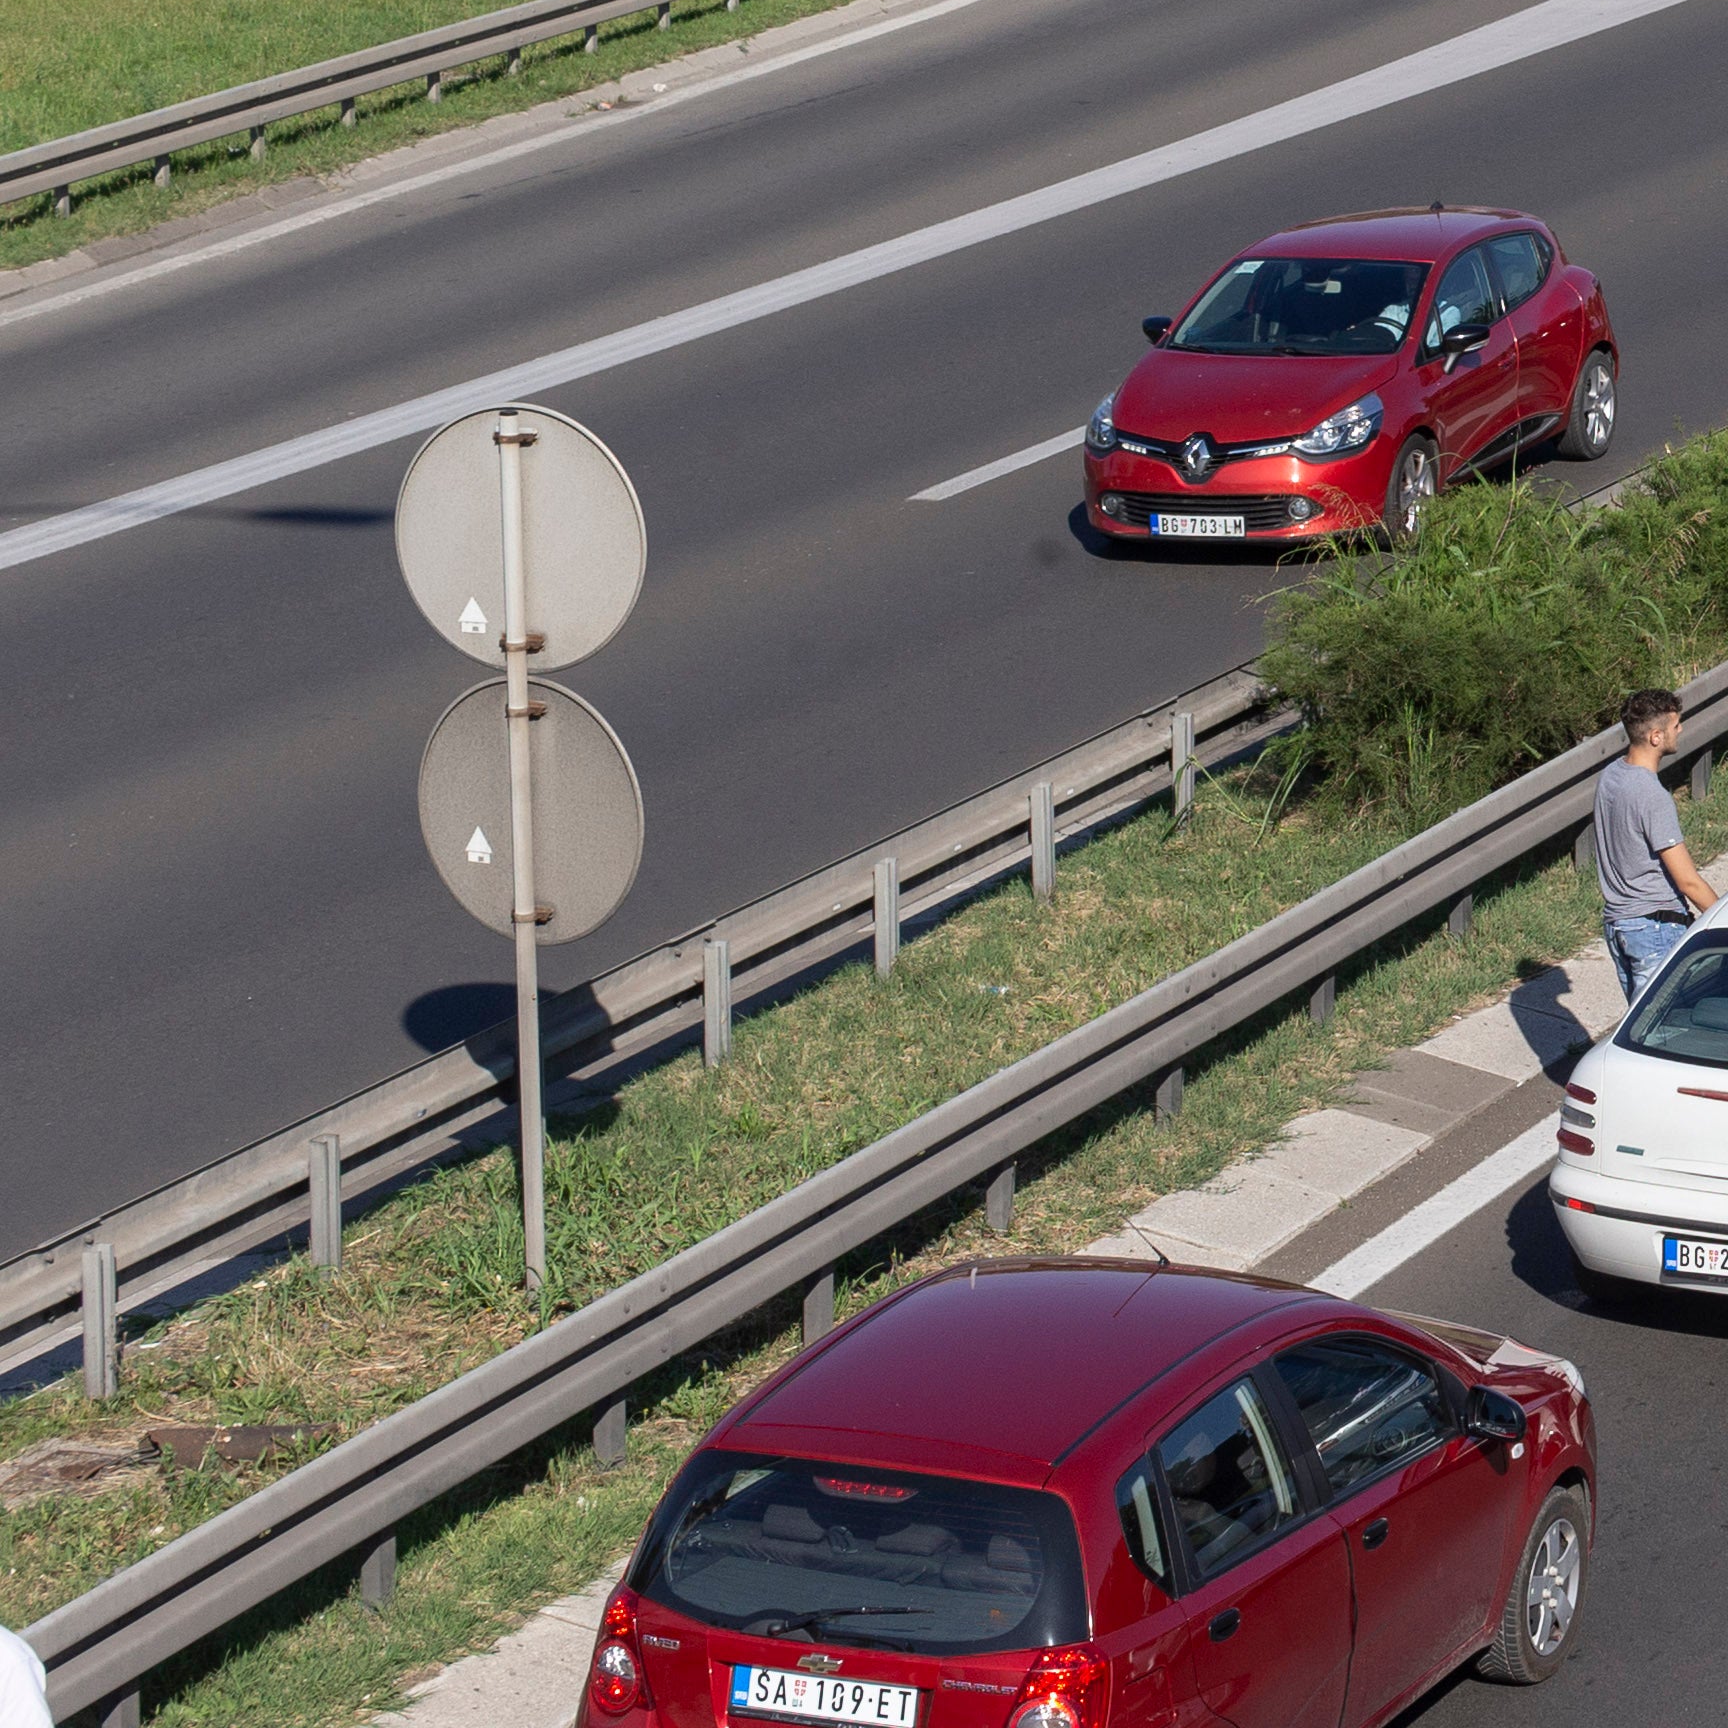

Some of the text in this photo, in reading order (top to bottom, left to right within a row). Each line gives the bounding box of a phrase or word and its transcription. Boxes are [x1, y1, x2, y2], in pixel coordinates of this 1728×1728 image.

[1161, 517, 1179, 533] BG
[1679, 1244, 1705, 1268] BG
[755, 1669, 787, 1706] ŠA
